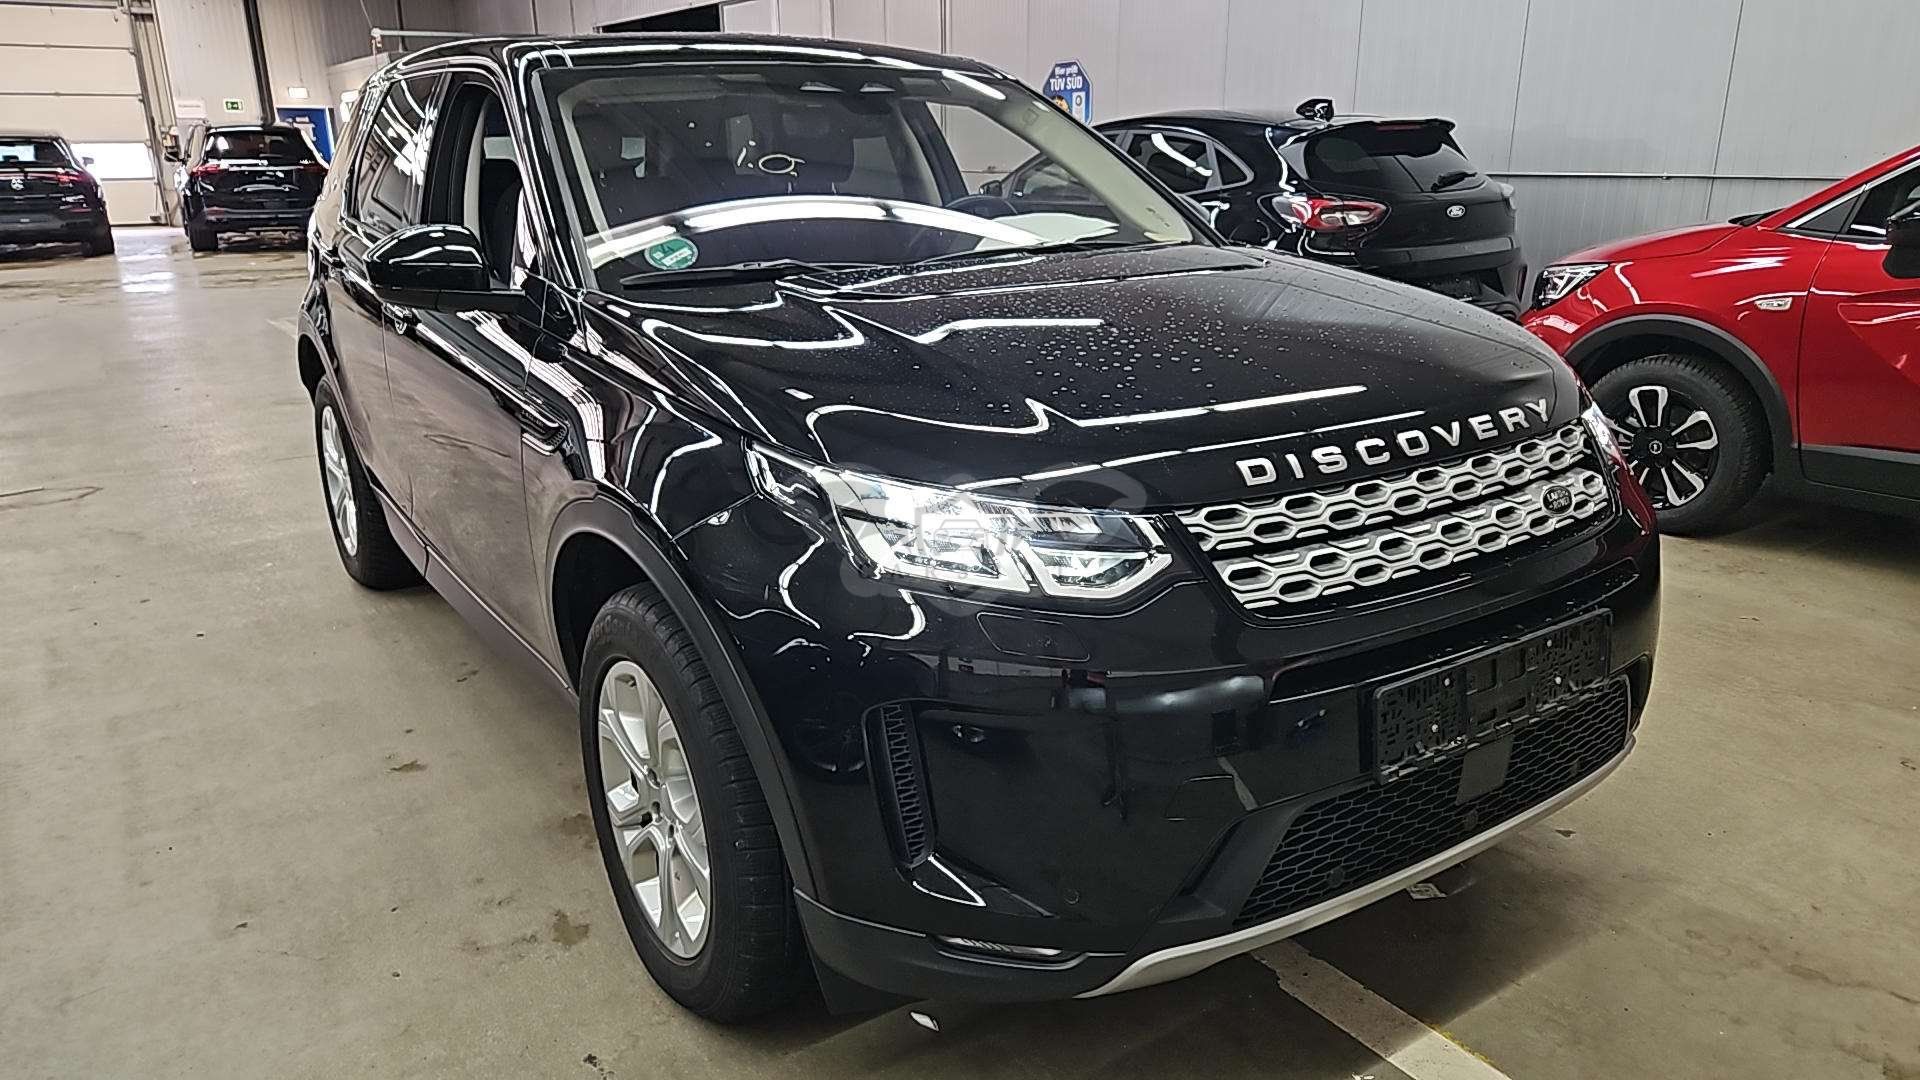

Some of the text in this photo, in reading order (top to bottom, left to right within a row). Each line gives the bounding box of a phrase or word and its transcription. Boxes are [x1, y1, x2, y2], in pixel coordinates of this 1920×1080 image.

[1050, 74, 1082, 91] TÜV SÜD
[1236, 399, 1548, 486] DISCOVERY
